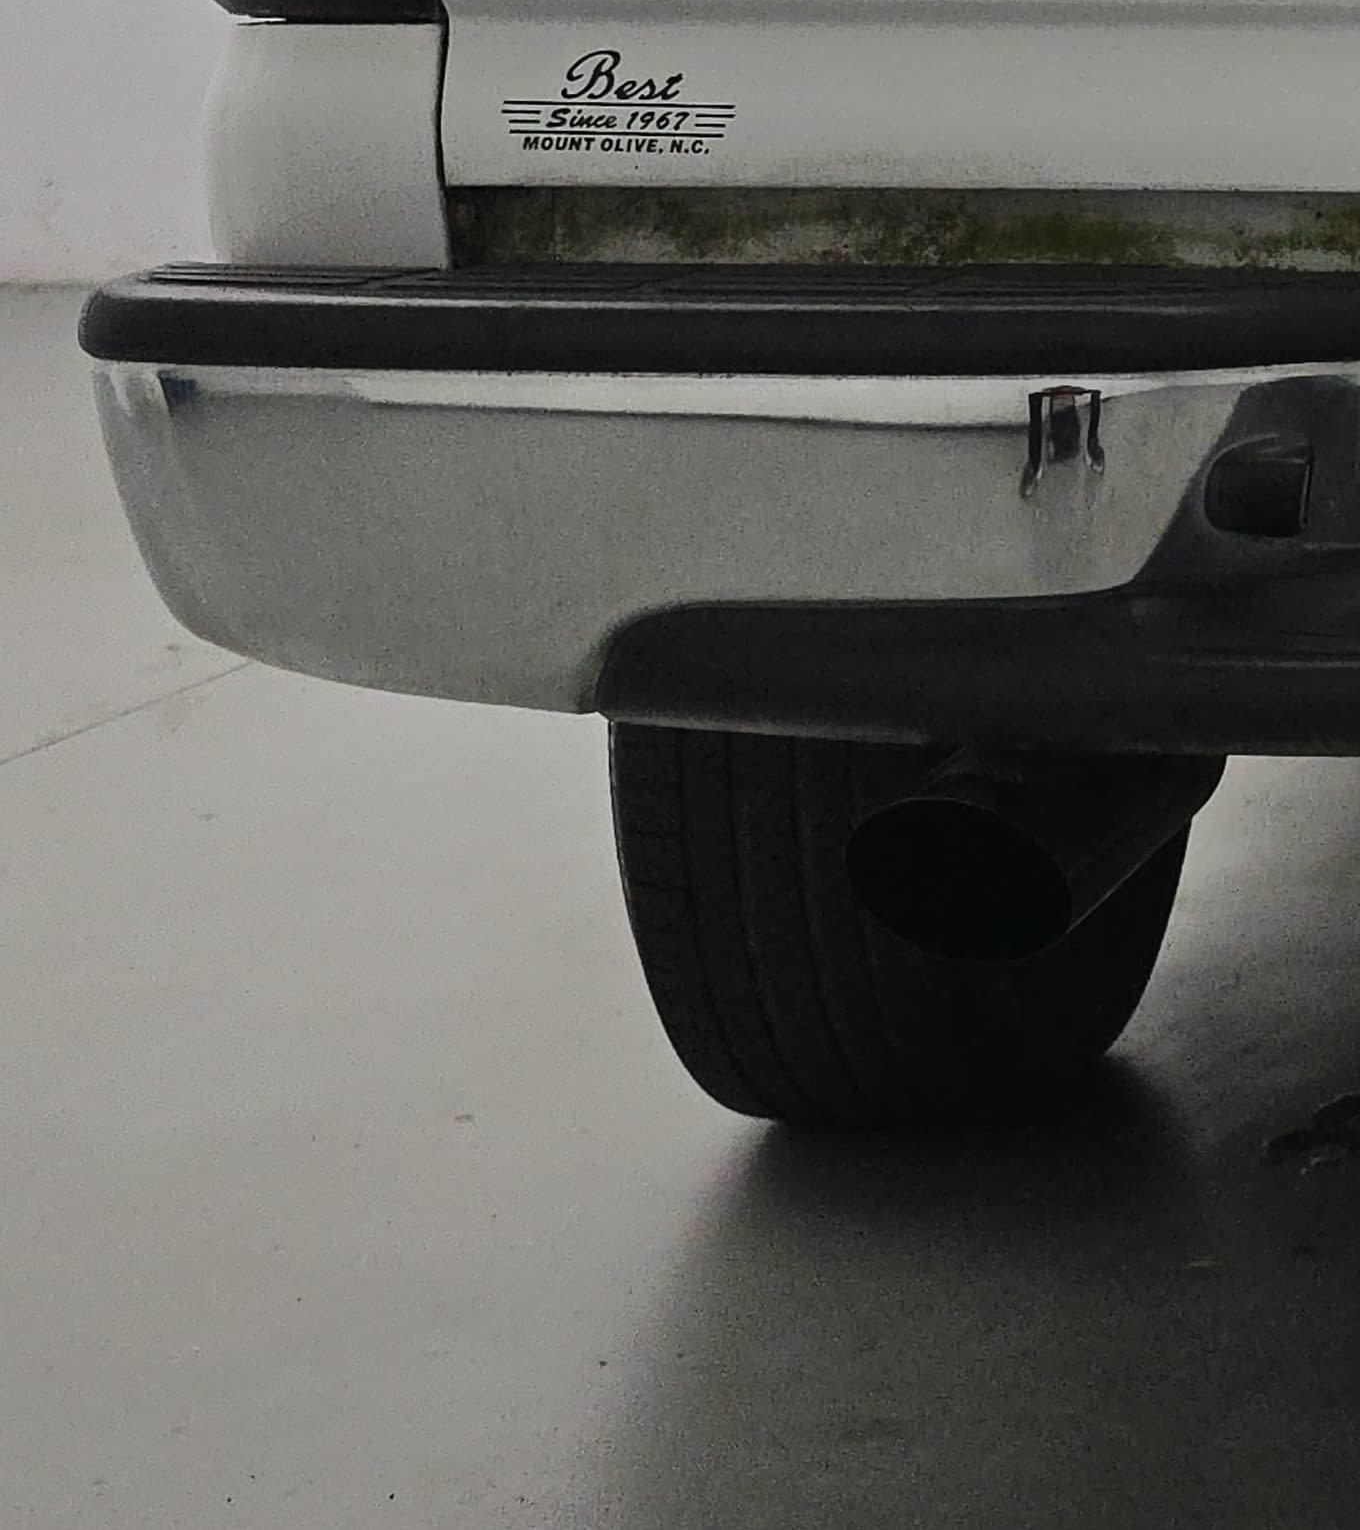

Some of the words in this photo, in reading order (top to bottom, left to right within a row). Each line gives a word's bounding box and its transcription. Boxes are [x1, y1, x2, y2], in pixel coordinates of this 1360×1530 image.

[561, 50, 683, 100] Best
[546, 108, 617, 128] Since
[626, 111, 690, 130] 1967
[522, 136, 595, 151] MOUNT
[670, 140, 710, 154] N.C.
